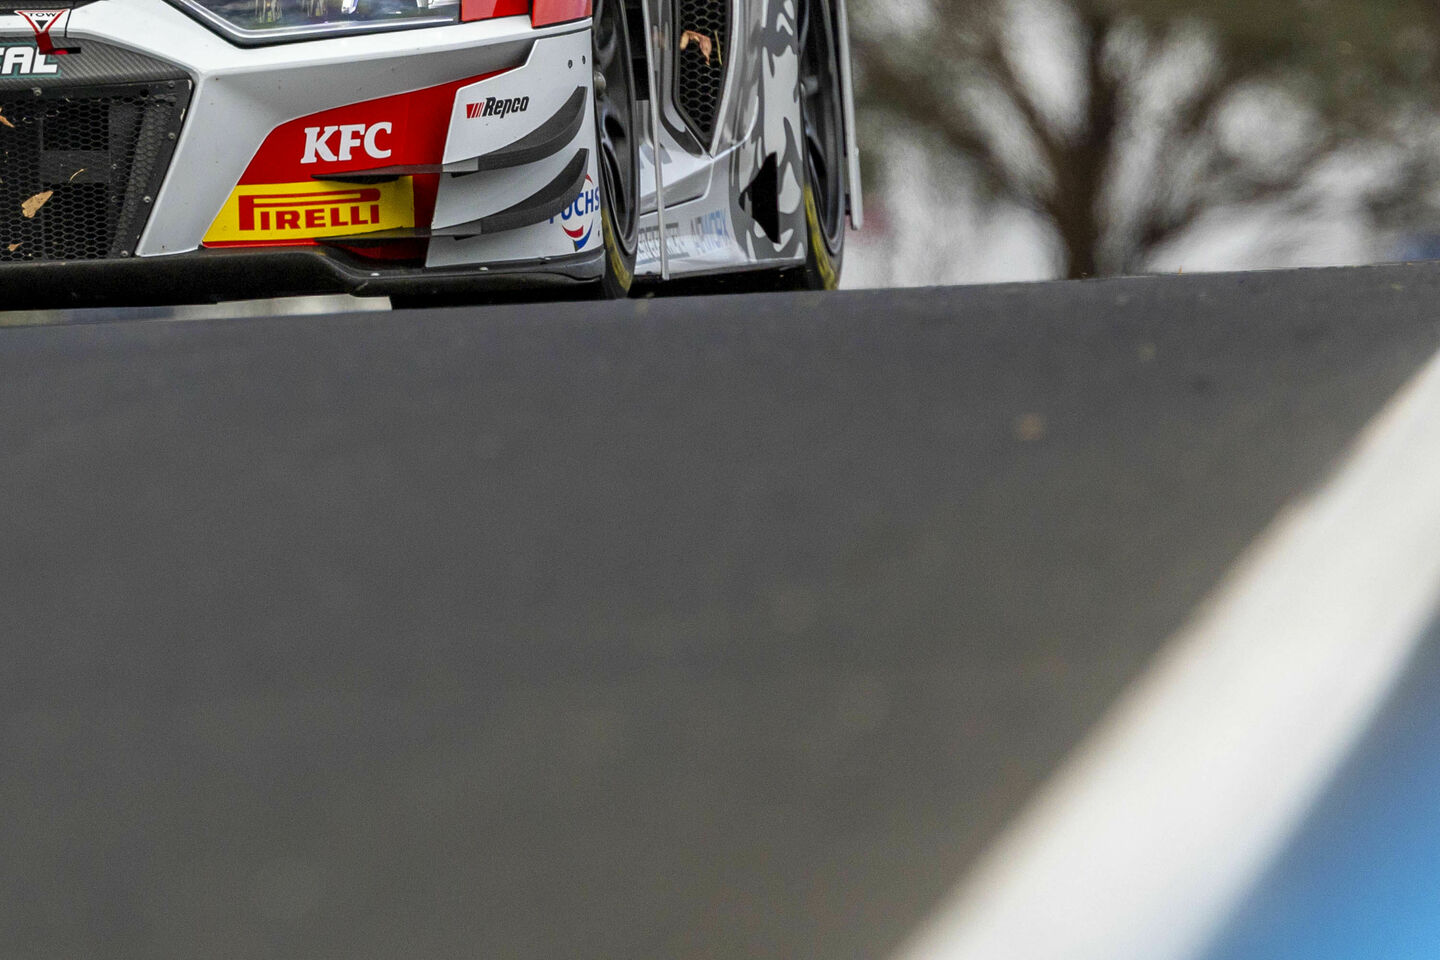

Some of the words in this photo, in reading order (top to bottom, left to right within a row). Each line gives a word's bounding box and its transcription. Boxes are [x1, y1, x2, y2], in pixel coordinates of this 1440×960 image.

[482, 96, 529, 119] Repco
[300, 121, 393, 164] KFC
[238, 188, 381, 231] PIRELLI
